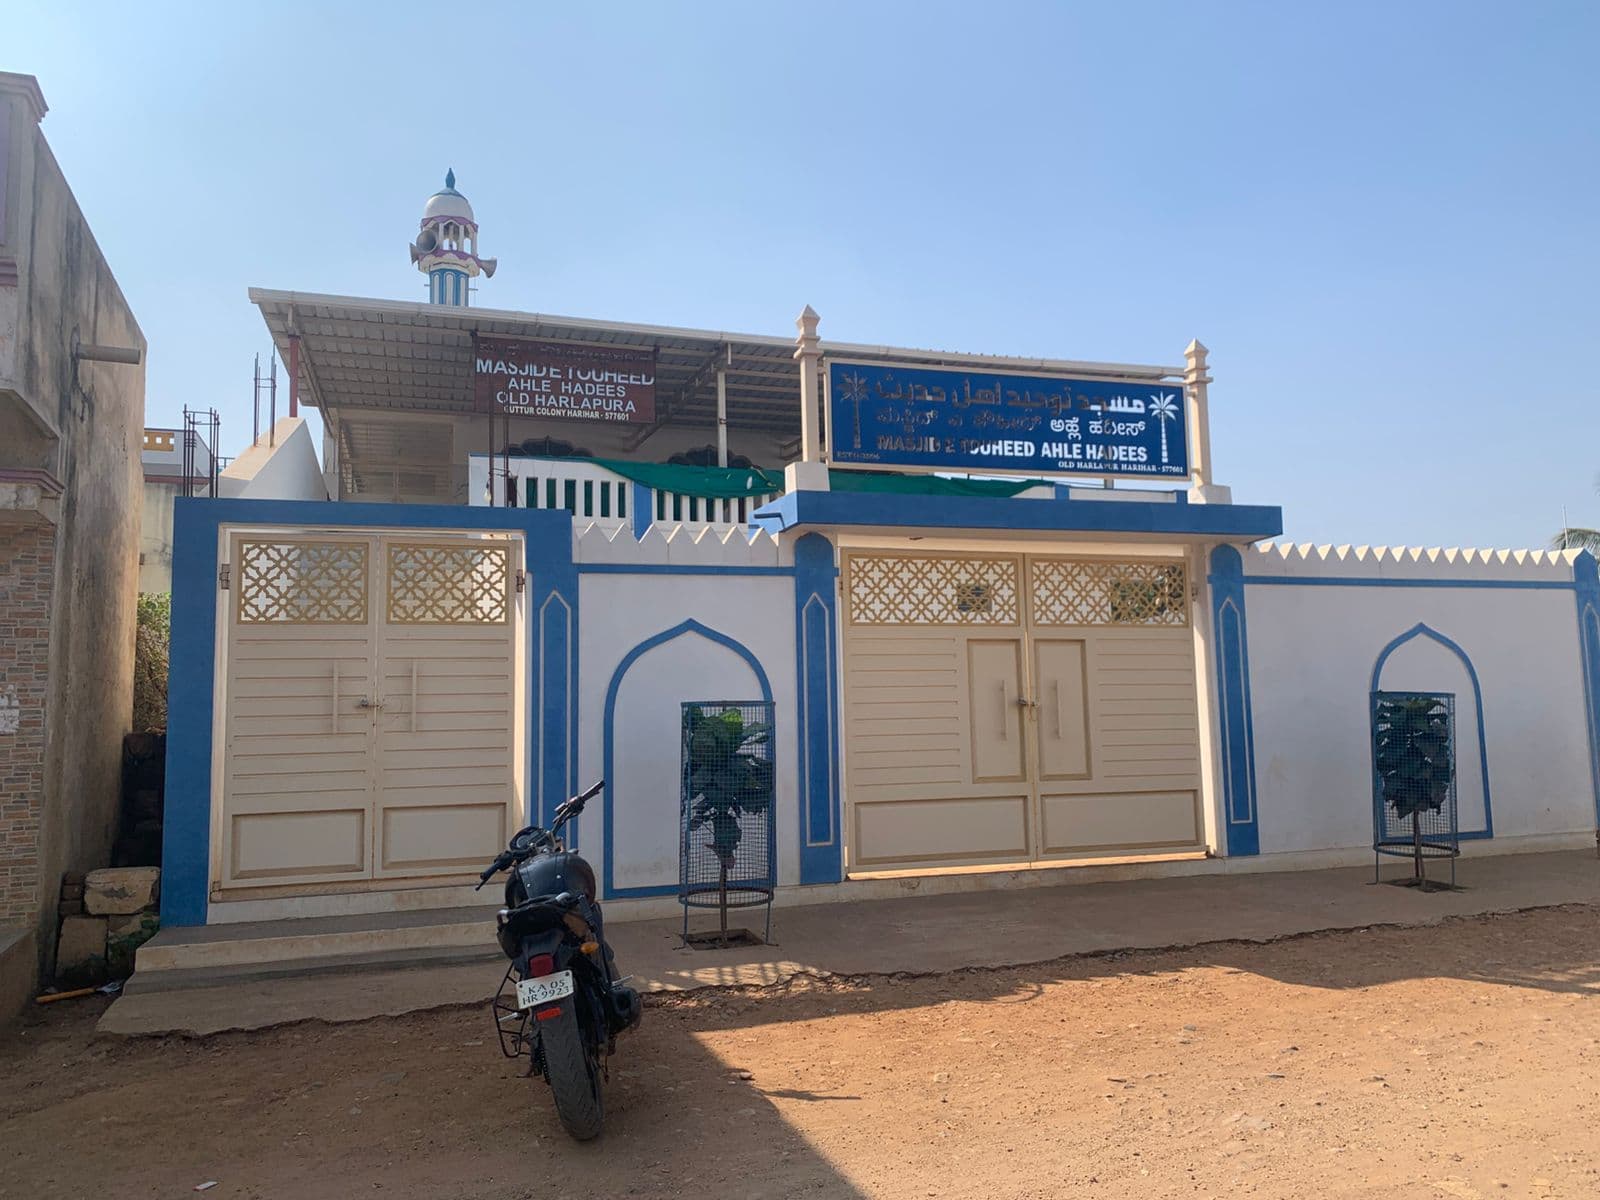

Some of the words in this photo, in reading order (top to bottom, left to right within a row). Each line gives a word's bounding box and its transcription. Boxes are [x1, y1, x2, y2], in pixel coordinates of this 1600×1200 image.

[508, 377, 552, 393] AHLE
[562, 381, 627, 398] HADEES
[496, 391, 529, 405] OLD
[535, 394, 636, 411] HARLAPURA
[536, 407, 566, 417] COLONY
[567, 409, 600, 419] HARIHAR
[877, 434, 942, 453] MASJID
[960, 438, 1035, 457] TOUHEED
[1041, 441, 1082, 459] AHLE
[1086, 443, 1148, 462] HADEES
[1058, 460, 1075, 468] OLD
[1121, 463, 1157, 472] HARIHAR
[522, 994, 538, 1005] HR
[541, 986, 569, 998] 9923
[528, 984, 546, 994] KA
